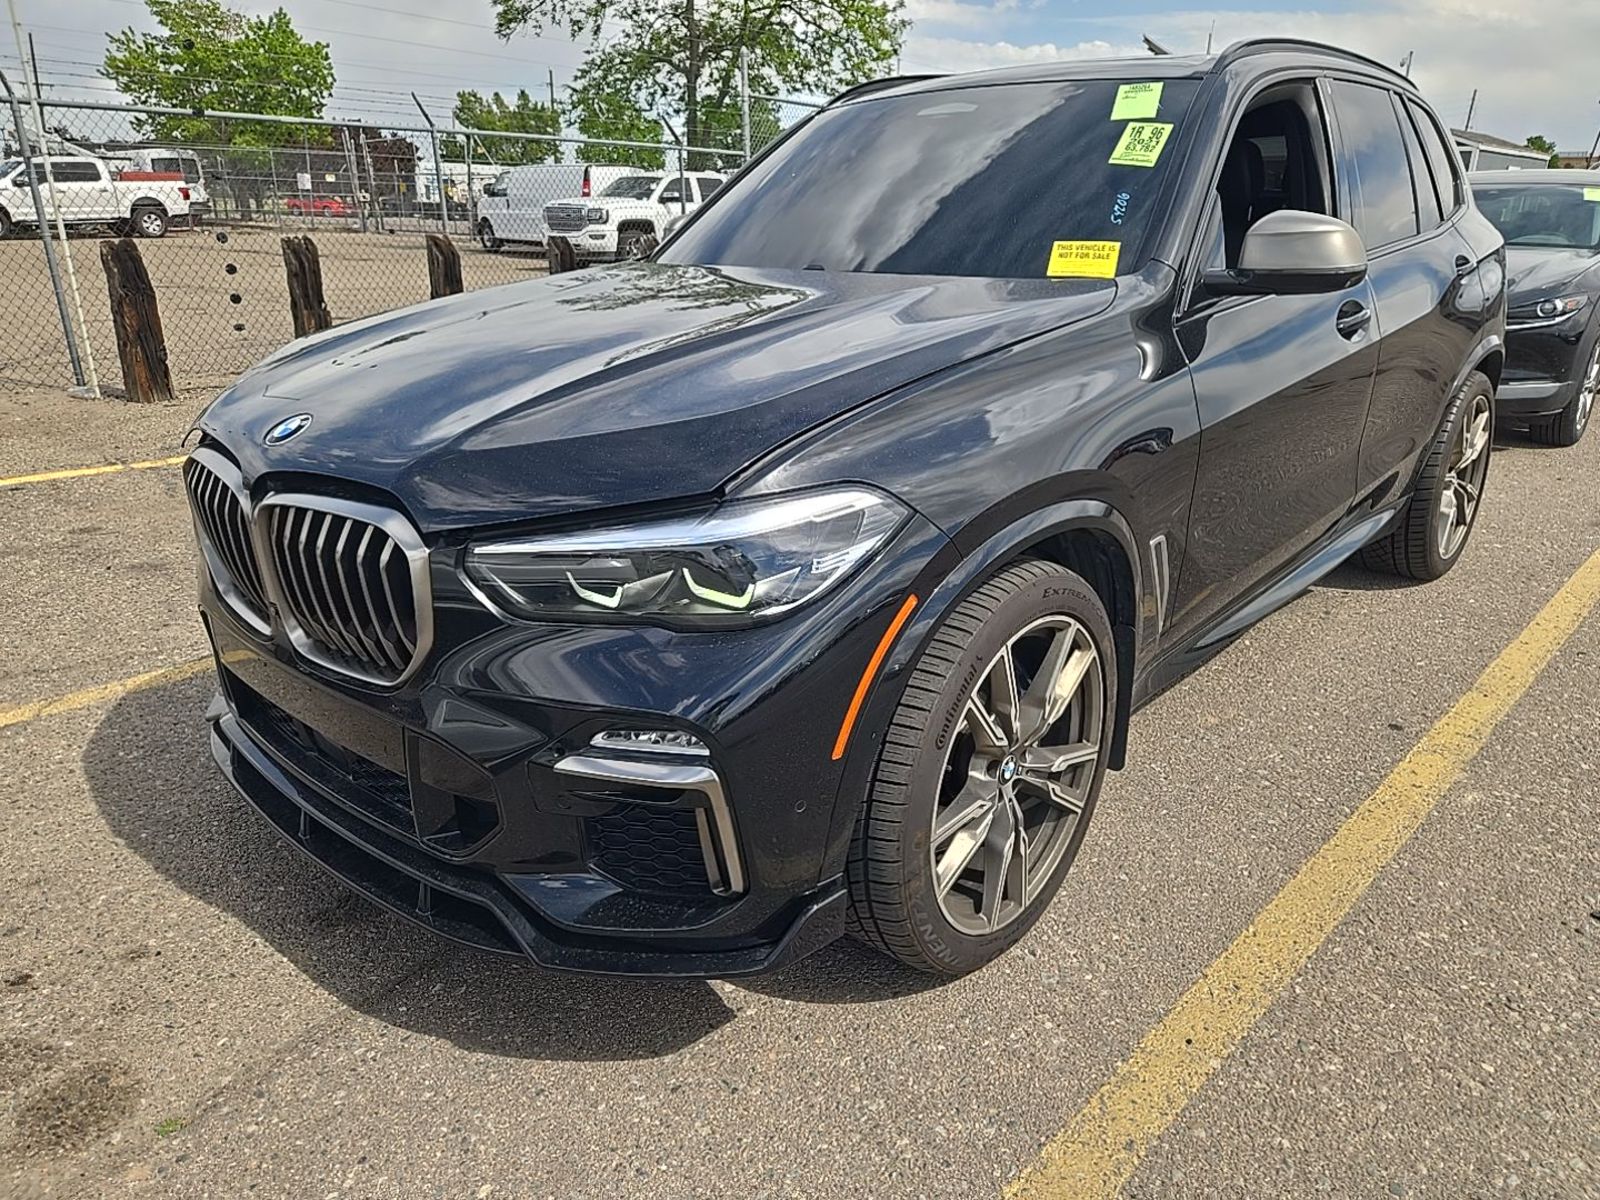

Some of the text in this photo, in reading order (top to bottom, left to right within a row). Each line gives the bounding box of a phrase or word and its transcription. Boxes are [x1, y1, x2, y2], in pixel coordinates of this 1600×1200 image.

[1149, 126, 1165, 140] 96
[1057, 243, 1073, 251] THIS
[1075, 244, 1107, 252] VEHICLE
[1092, 252, 1111, 260] SALE
[935, 664, 977, 750] Continental
